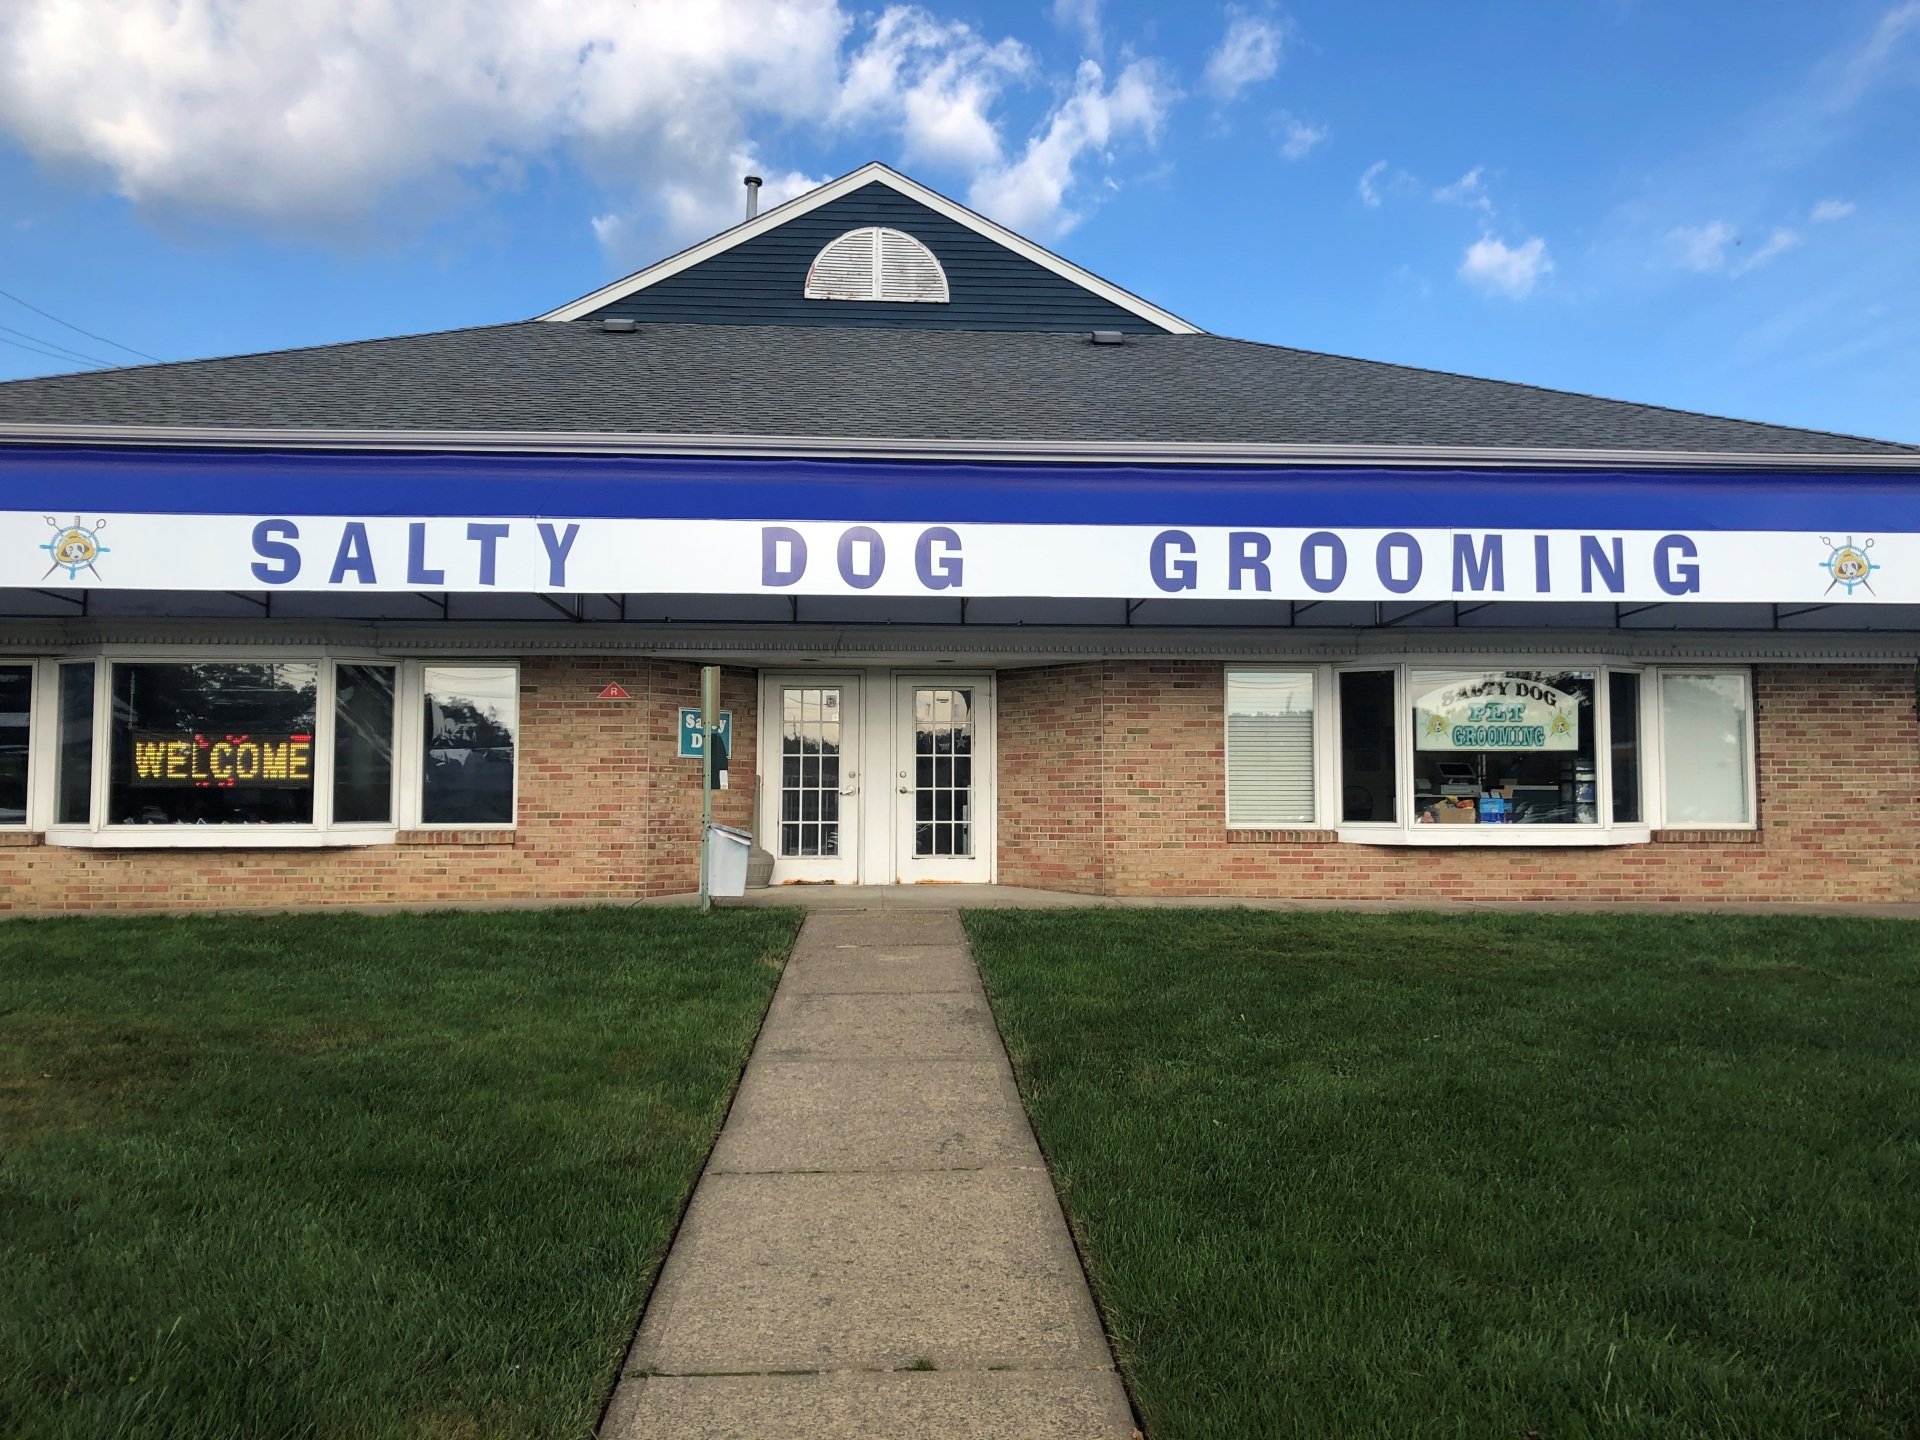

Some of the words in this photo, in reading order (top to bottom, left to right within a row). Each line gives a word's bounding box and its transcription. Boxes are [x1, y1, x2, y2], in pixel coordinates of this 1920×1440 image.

[251, 519, 580, 587] SALTY
[762, 526, 963, 590] DOG
[1149, 530, 1699, 596] GROOMING
[610, 687, 618, 696] R
[1441, 682, 1509, 707] SALTY
[1516, 682, 1557, 708] DOG
[685, 713, 727, 734] Say
[1468, 702, 1526, 723] PET
[1452, 725, 1545, 747] GROOMING
[135, 741, 310, 779] WELCOME
